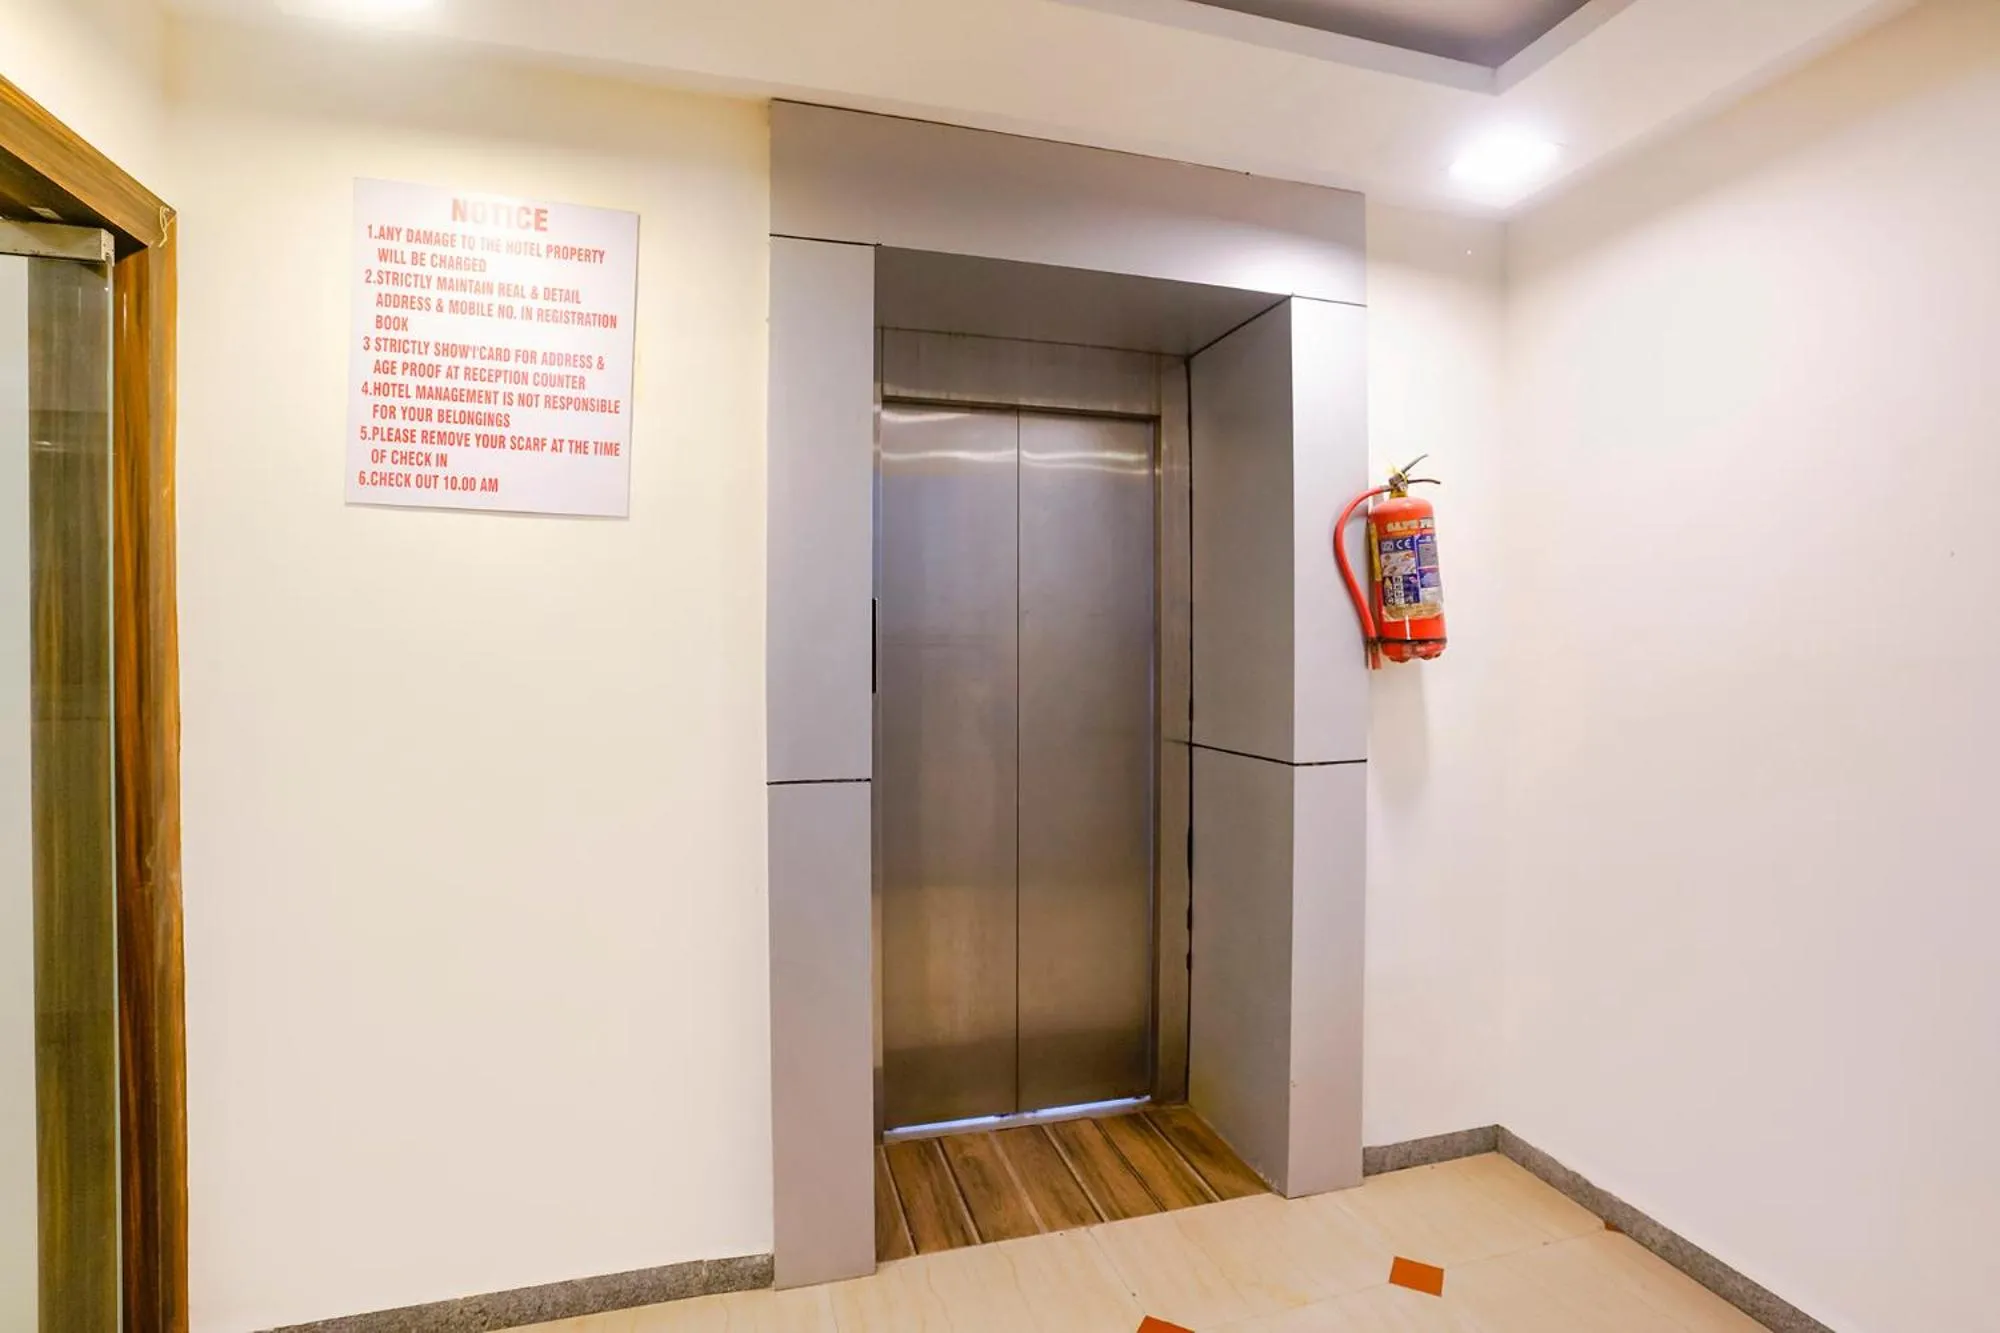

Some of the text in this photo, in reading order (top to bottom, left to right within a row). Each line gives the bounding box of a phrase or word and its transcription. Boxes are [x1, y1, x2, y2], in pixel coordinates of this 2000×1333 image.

[451, 199, 549, 232] NOTICE
[367, 225, 605, 264] 1.ANY DAMAGE TO THE HOTEL PROPERTY
[378, 248, 487, 272] WILL BE CHARGED
[365, 269, 581, 304] 2.STRICTLY MAINTAIN REAL & DETAIL
[375, 315, 409, 331] BOOK
[376, 293, 617, 329] ADDRESS & MOBILE NO. IN REGISTRATION
[375, 338, 430, 356] STRICTLY
[514, 350, 537, 364] FOR
[541, 352, 593, 369] ADDRESS
[596, 356, 605, 370] &
[373, 360, 586, 390] AGE PROOF AT RECEPTION COUNTER
[362, 381, 621, 414] 4.HOTEL MANAGEMENT IS NOT RESPONSIBLE
[372, 405, 511, 428] FOR YOUR BELONGINGS
[360, 426, 621, 457] 5.PLEASE REMOVE YOUR SCARF AT THE TIME
[371, 449, 448, 467] OF CHECK IN
[359, 471, 499, 493] 6.CHECK OUT 10.00 AM
